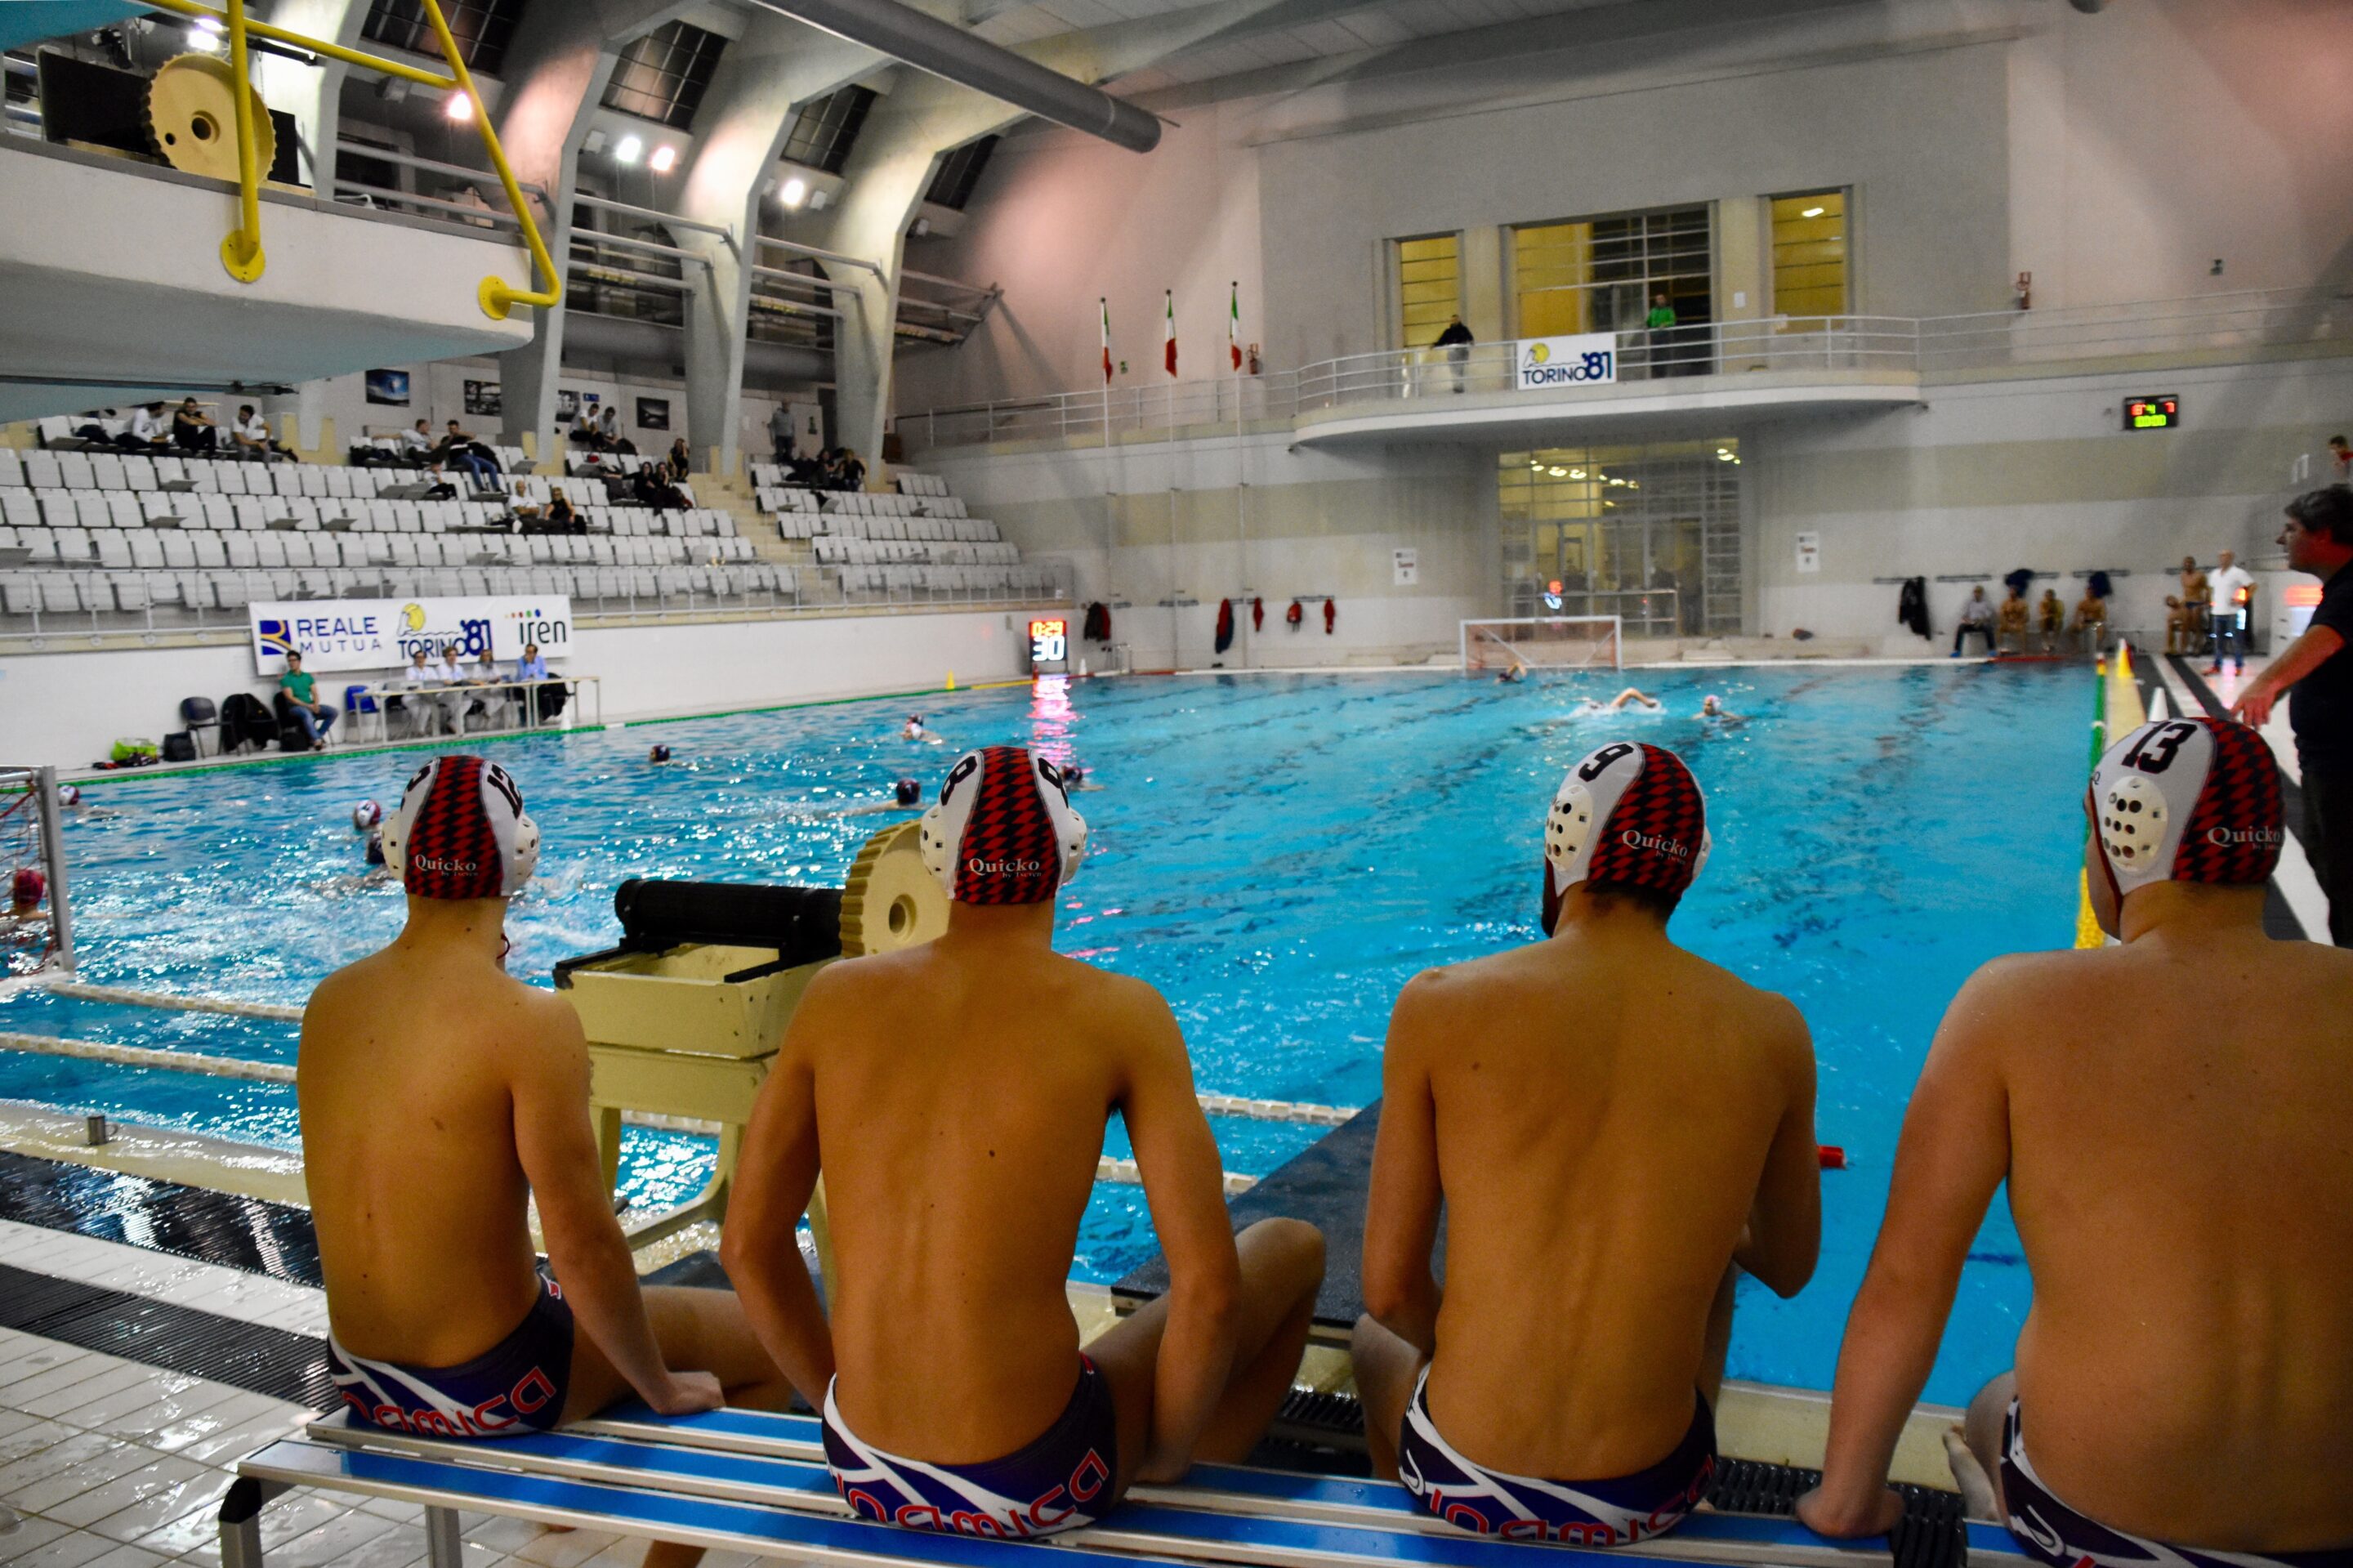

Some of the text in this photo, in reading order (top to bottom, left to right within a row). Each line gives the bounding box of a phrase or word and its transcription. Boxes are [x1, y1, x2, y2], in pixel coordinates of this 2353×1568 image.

[1522, 366, 1587, 385] TORINO
[297, 616, 379, 637] REALE
[519, 620, 567, 645] iren
[1032, 621, 1065, 637] 0:29
[300, 638, 382, 654] MUTUA
[397, 637, 468, 660] TORINO
[1032, 636, 1065, 662] 30
[2121, 721, 2198, 775] 13
[1578, 743, 1634, 783] 9
[940, 755, 978, 806] 8
[1622, 829, 1688, 857] Quicko
[2207, 825, 2280, 847] Quicko
[415, 854, 476, 873] Quicko
[968, 858, 1040, 876] Quicko
